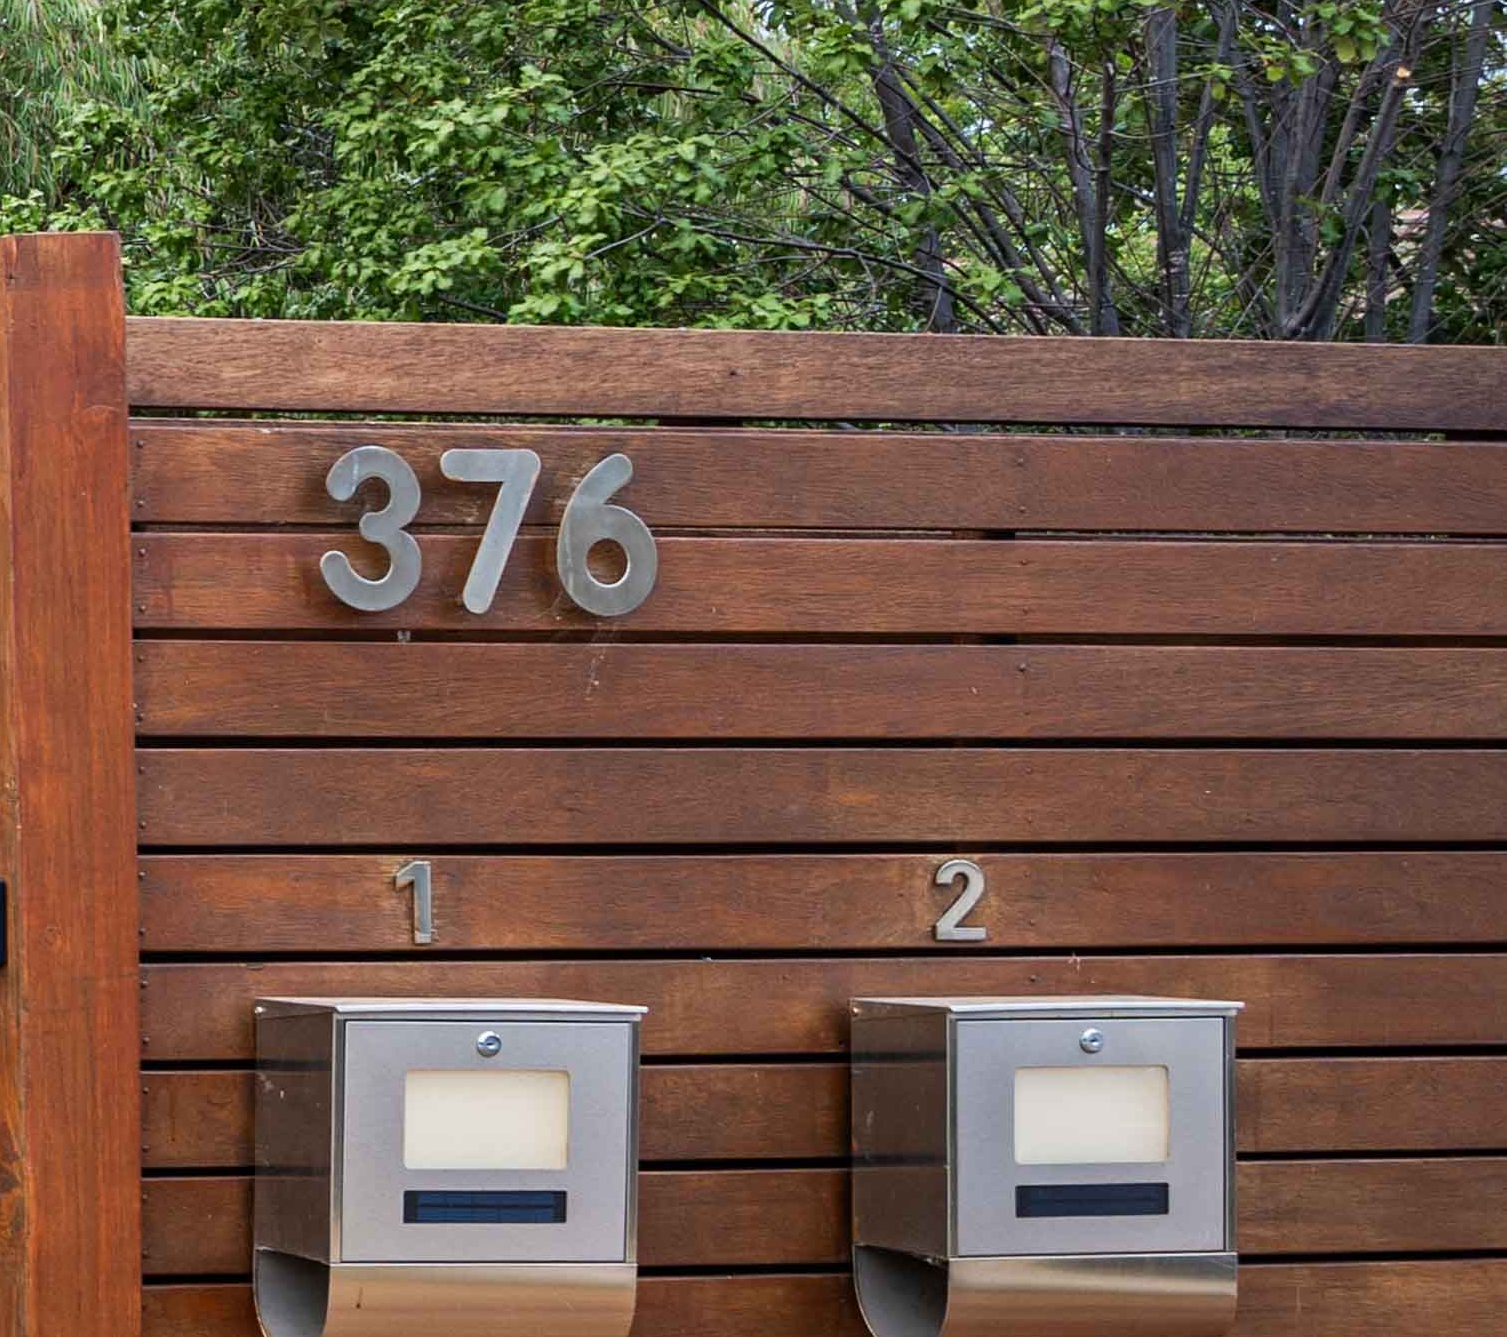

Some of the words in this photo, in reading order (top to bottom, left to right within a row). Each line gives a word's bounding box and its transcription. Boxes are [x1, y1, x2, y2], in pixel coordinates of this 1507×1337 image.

[319, 445, 658, 617] 376
[394, 861, 432, 944] 1
[935, 858, 987, 941] 2
